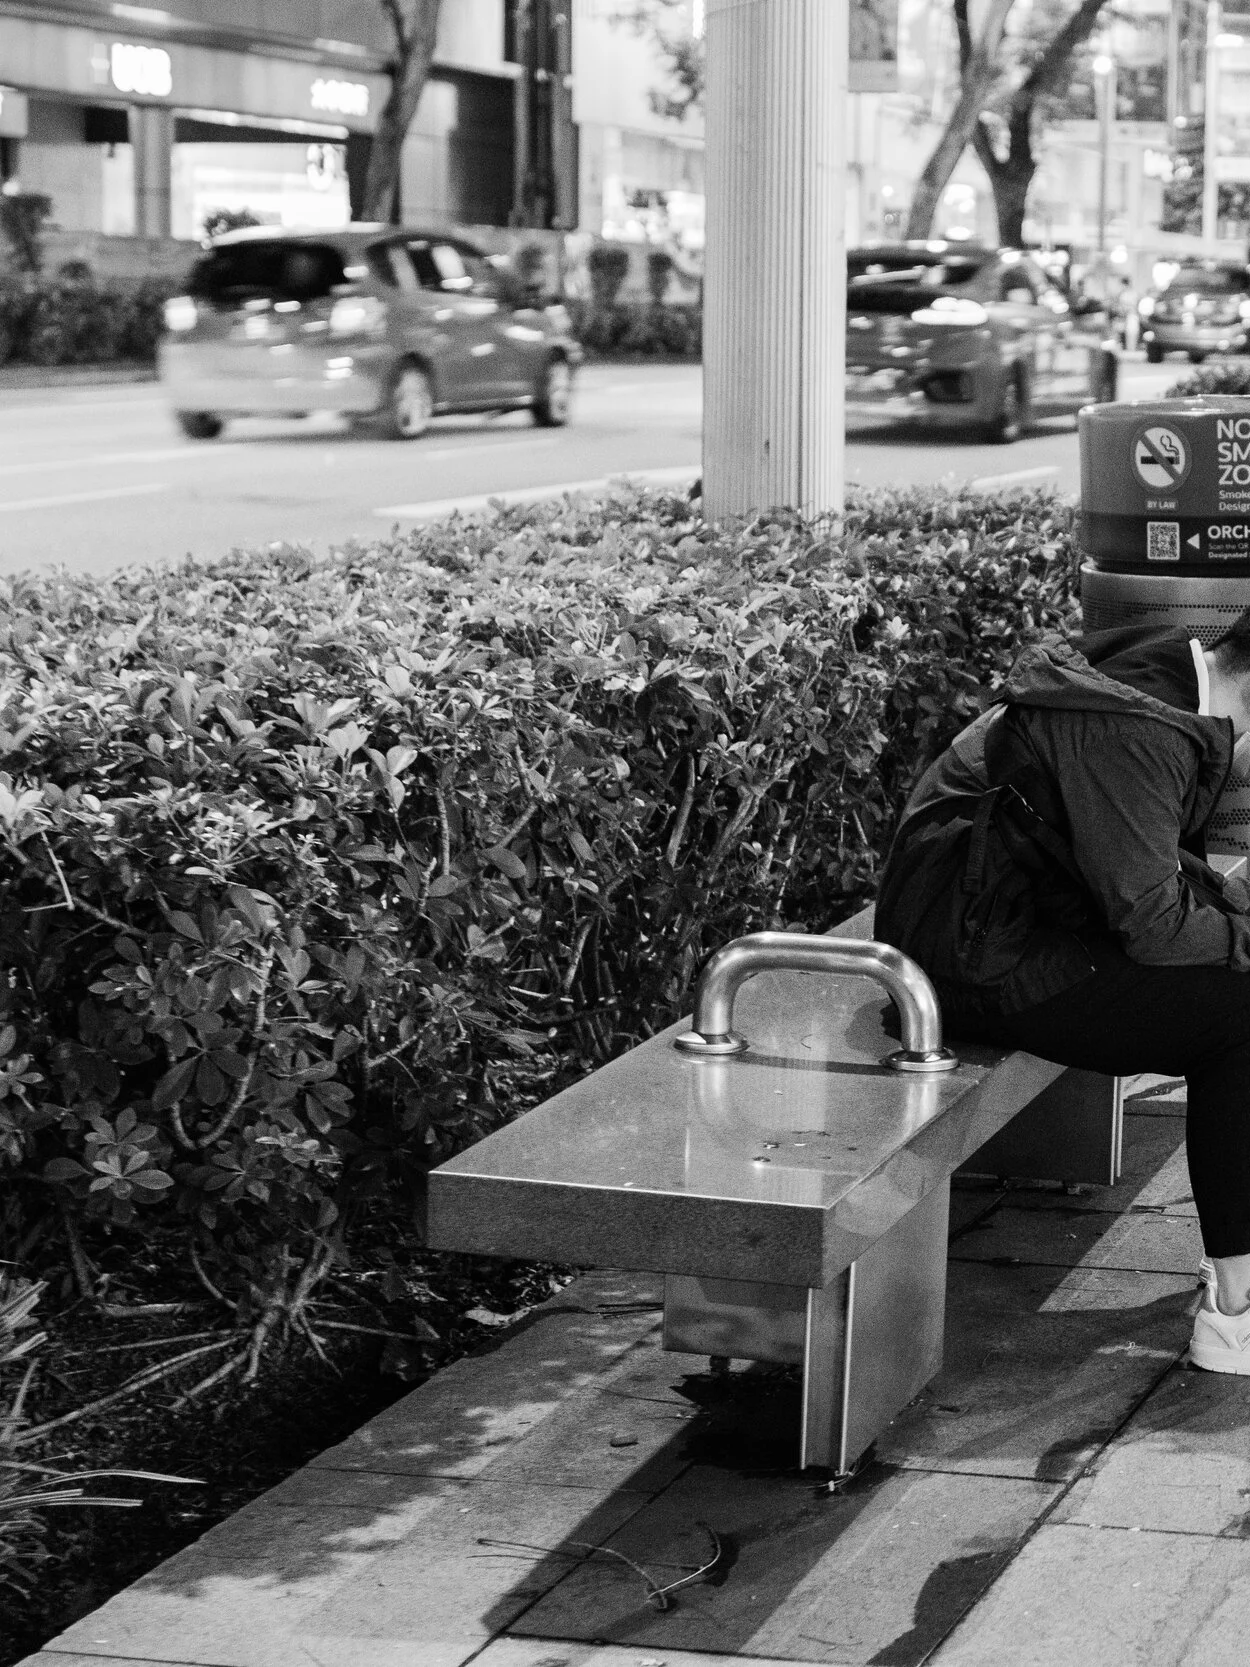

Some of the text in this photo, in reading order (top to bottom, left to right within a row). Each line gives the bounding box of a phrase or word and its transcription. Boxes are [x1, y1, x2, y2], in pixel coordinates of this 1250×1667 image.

[1147, 500, 1176, 509] BY LAW
[1208, 543, 1224, 551] Scan
[1225, 542, 1237, 550] the
[1238, 542, 1249, 550] QR
[1208, 551, 1248, 560] Designated
